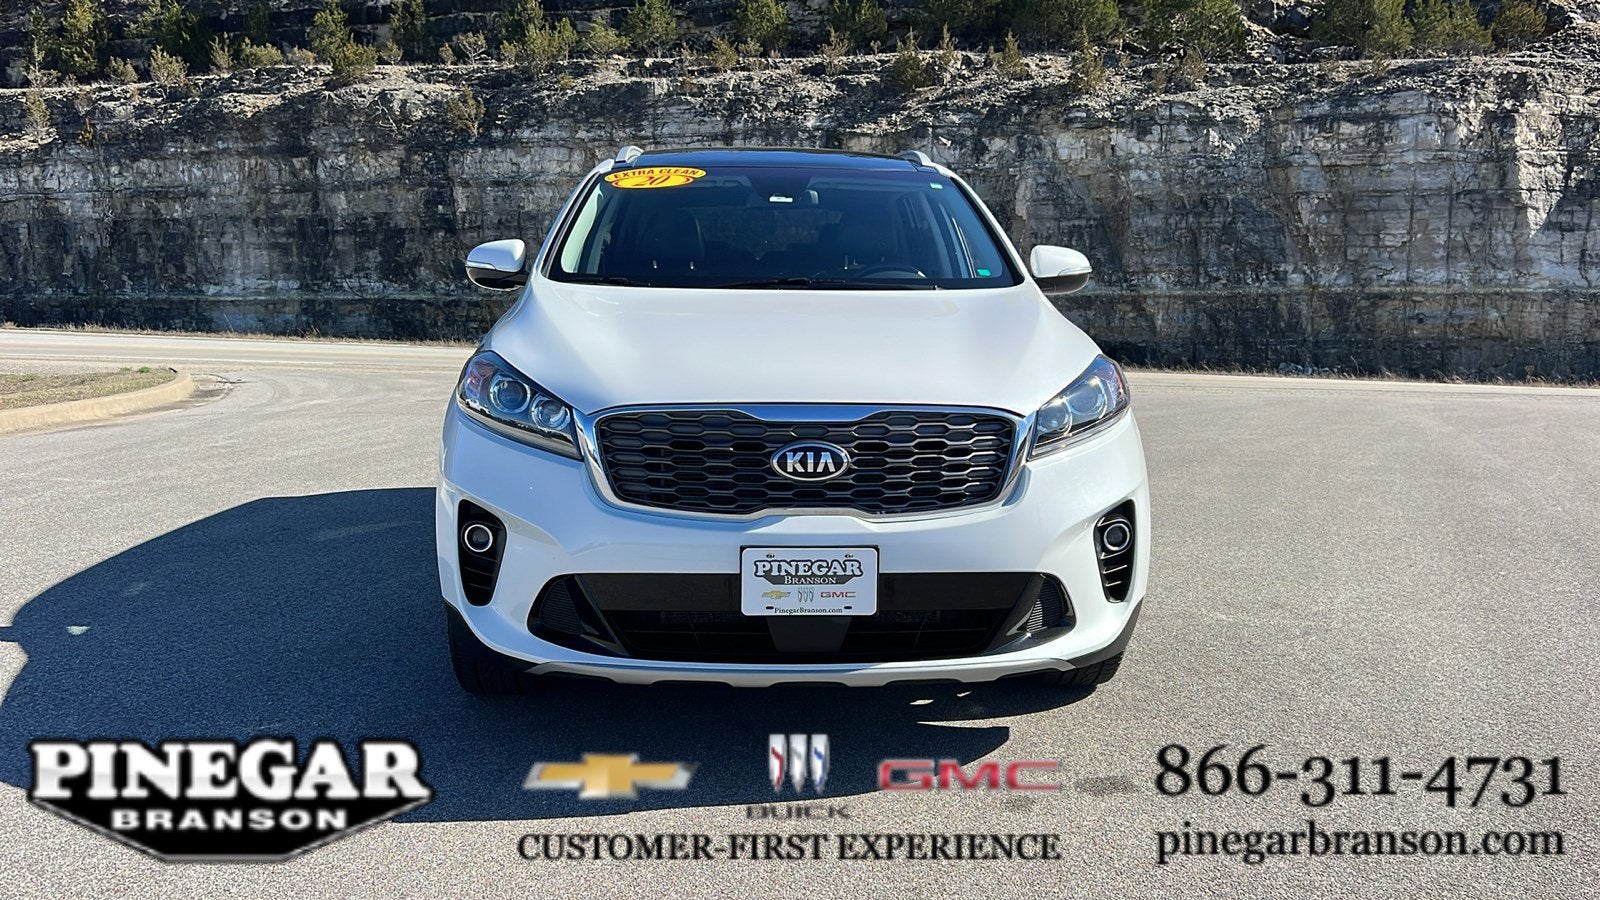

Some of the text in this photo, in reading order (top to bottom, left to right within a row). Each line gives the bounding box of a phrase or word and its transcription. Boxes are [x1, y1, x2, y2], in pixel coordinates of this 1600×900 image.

[613, 169, 655, 179] EXTRA
[786, 451, 836, 473] KIA
[755, 560, 863, 577] PINEGAR
[784, 575, 837, 585] BRANSON
[774, 607, 843, 615] PinegarBranson.com
